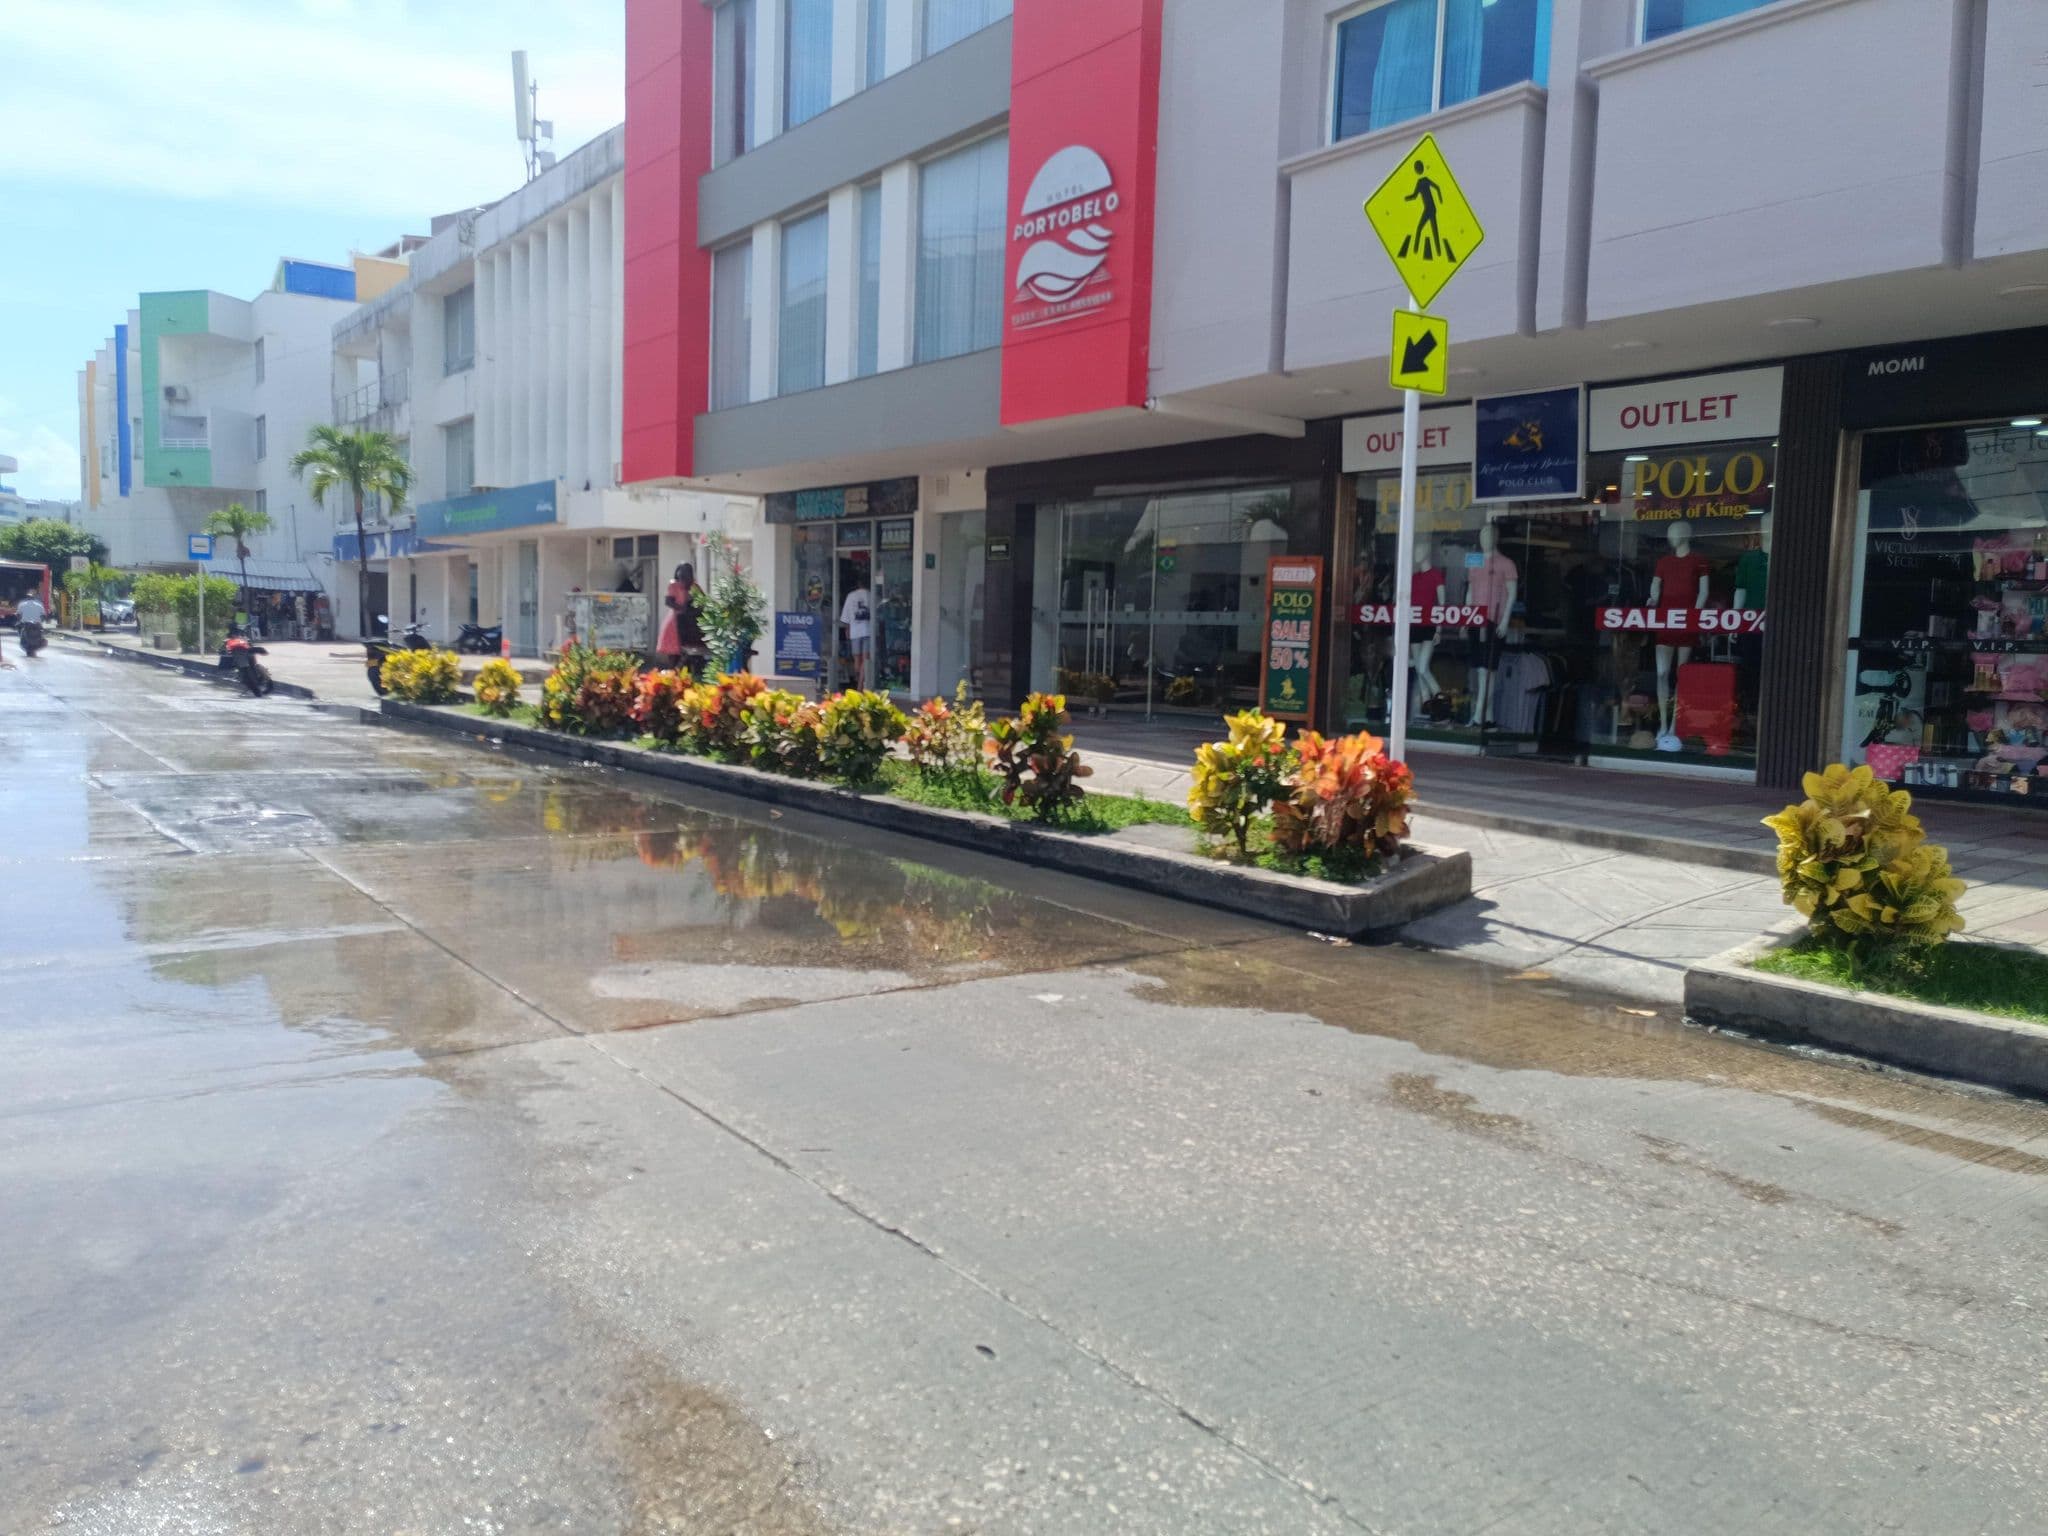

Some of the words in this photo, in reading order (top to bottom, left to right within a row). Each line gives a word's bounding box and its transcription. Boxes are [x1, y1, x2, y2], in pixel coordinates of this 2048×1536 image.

[1013, 192, 1119, 241] PORTOBELO
[1867, 356, 1925, 376] MOMI
[1620, 394, 1738, 429] OUTLET
[1366, 426, 1451, 453] OUET
[1634, 452, 1764, 500] POLO
[1634, 506, 1682, 522] Games
[1686, 504, 1700, 518] of
[1706, 502, 1750, 520] Kings
[1273, 592, 1312, 608] POLO
[1360, 604, 1423, 624] SAE
[1430, 606, 1484, 625] 50%
[1603, 608, 1687, 629] SALE
[1698, 609, 1767, 631] 50%
[1271, 619, 1311, 641] SALE
[1892, 640, 1934, 649] V.I.P.
[1973, 642, 2019, 651] V.I.P.
